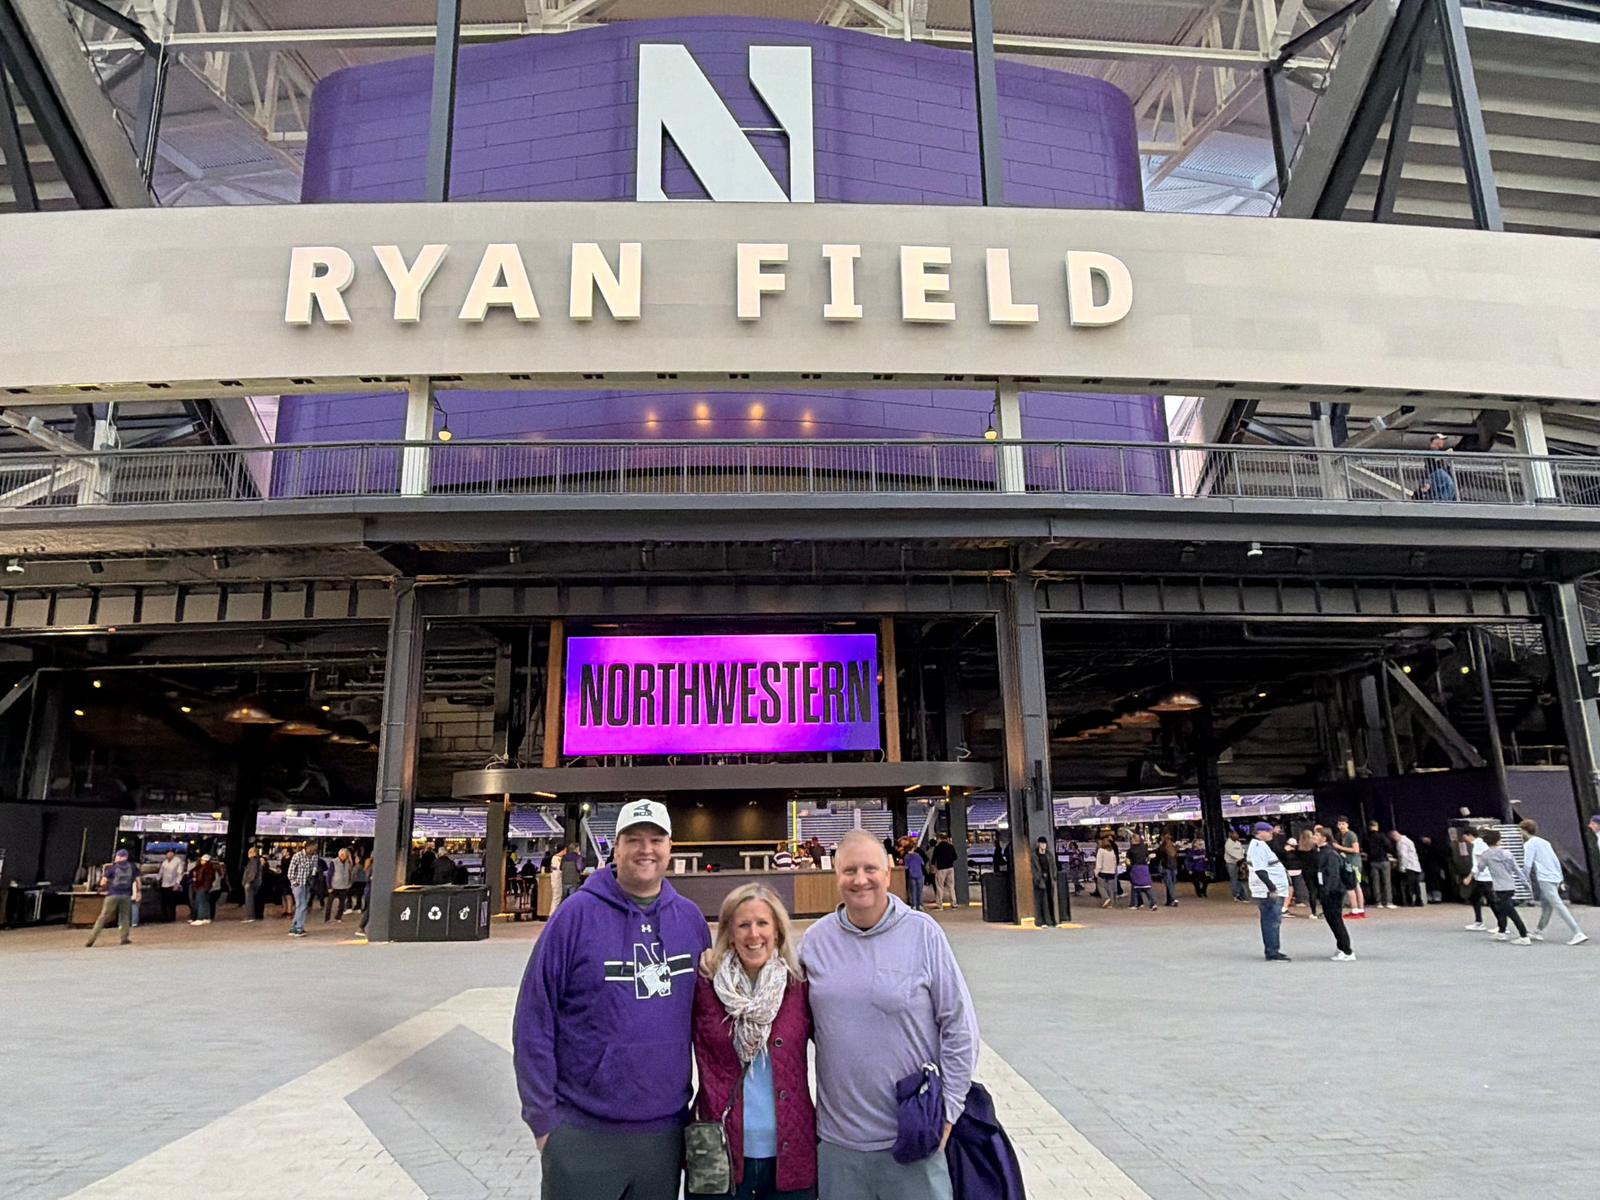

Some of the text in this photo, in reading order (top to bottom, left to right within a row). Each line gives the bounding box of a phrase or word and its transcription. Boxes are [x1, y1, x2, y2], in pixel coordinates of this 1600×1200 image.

[636, 43, 815, 203] N
[284, 242, 1134, 327] RYAN FIELD
[580, 660, 871, 726] NORTHWESTERN
